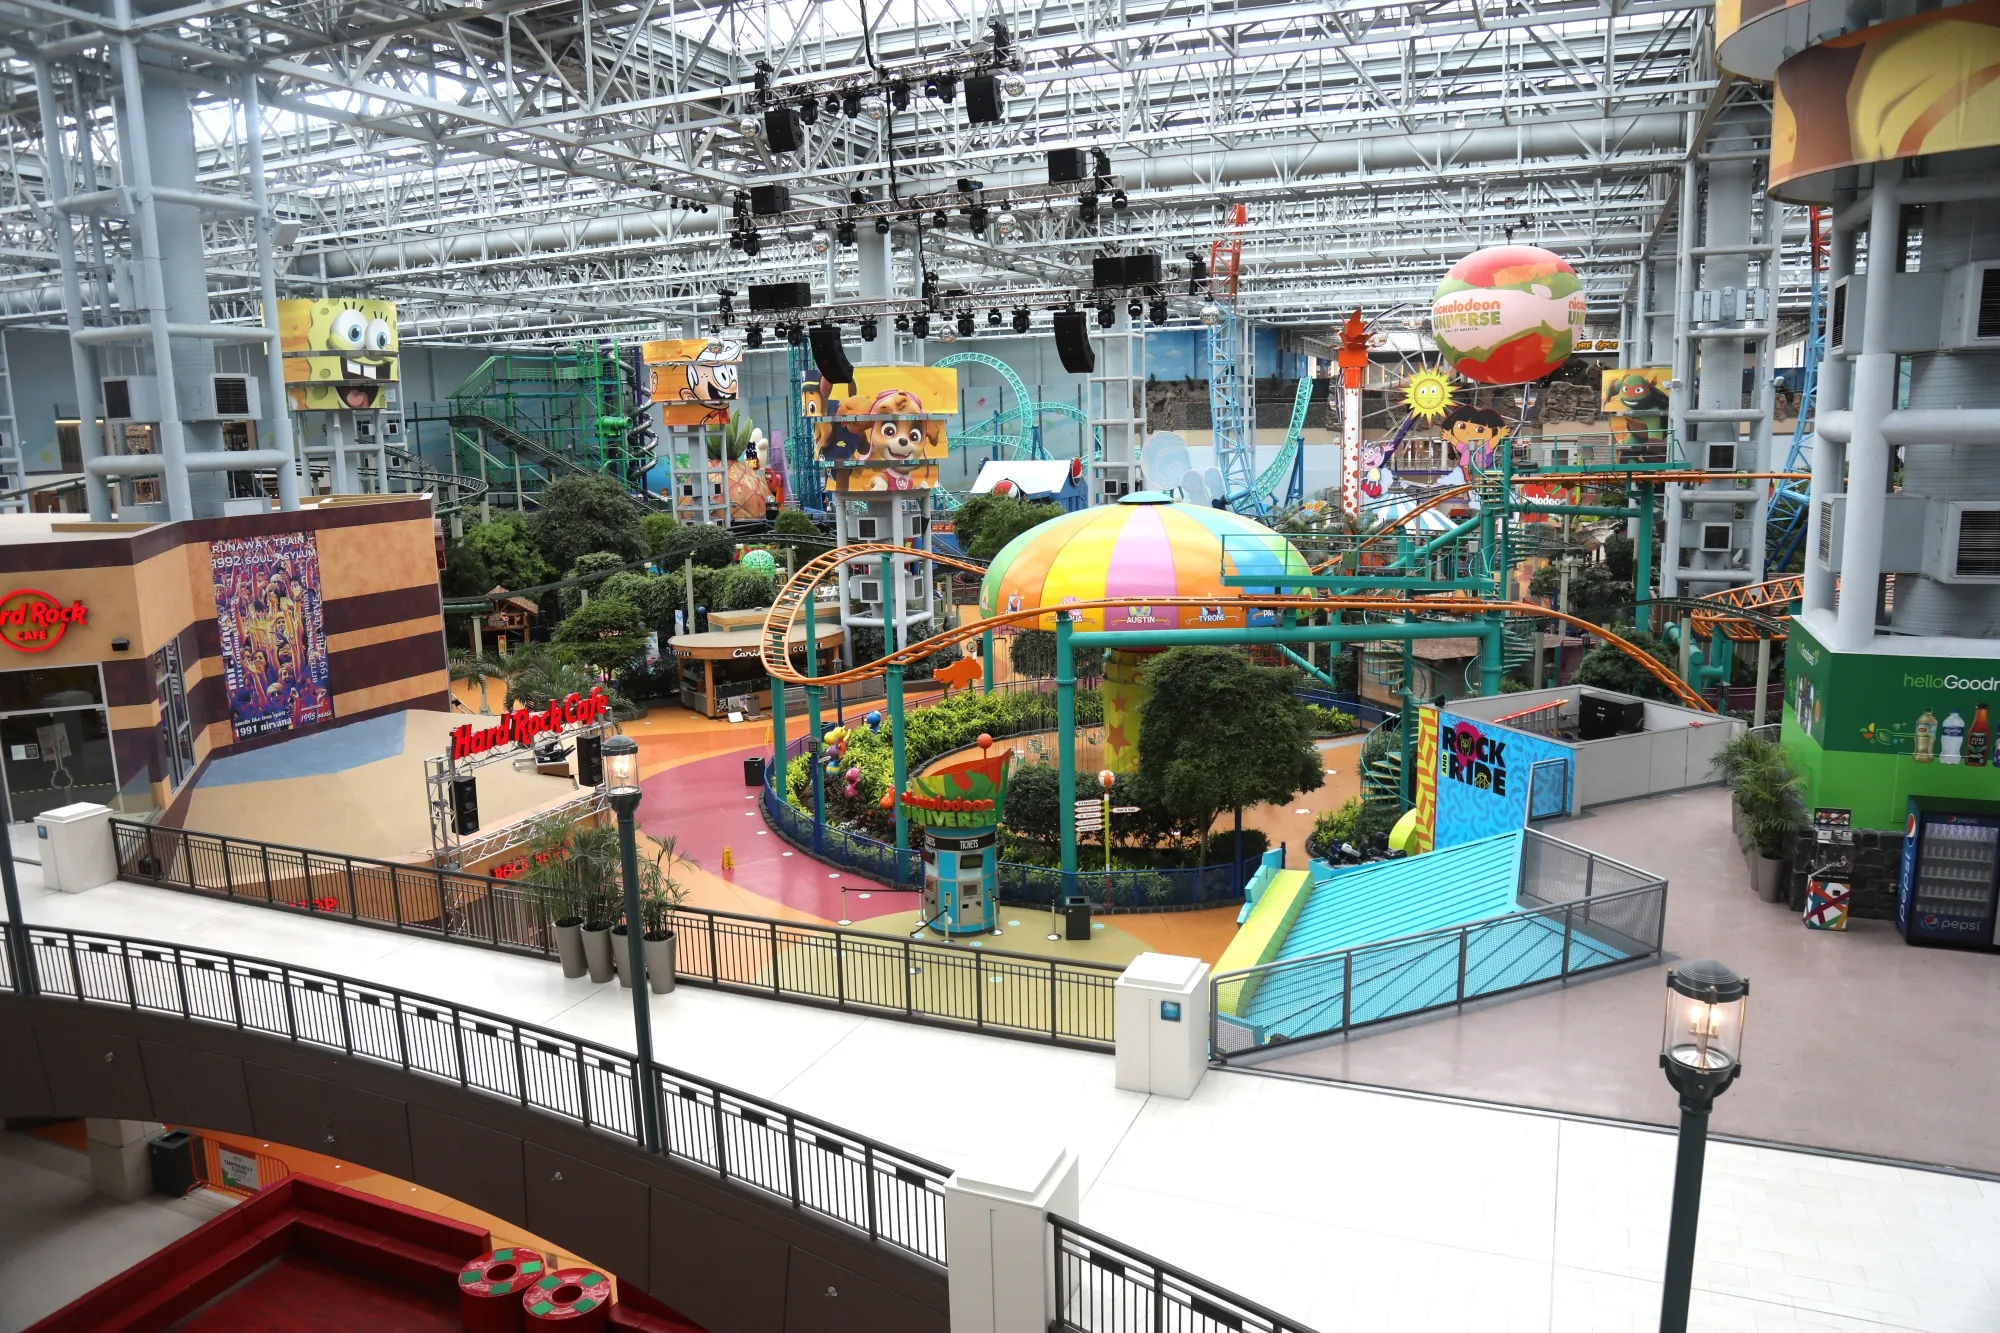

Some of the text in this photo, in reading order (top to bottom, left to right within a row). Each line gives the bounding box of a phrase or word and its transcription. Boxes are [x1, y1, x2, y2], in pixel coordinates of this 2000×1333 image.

[1434, 298, 1501, 315] nickelodeon
[1434, 311, 1501, 329] UNIVERSE
[1595, 340, 1619, 351] GOLF
[211, 535, 304, 554] RUNAWAY TRAIN
[211, 547, 316, 569] 1992 SOUL ASYLUM
[30, 600, 88, 628] Rock
[312, 595, 323, 630] VERVE
[1126, 615, 1156, 624] AUSTIN
[1199, 613, 1226, 623] TYRONE
[16, 629, 47, 641] CAFE
[319, 655, 329, 681] 1997
[234, 718, 251, 728] smells
[251, 715, 261, 724] like
[261, 713, 273, 721] teen
[235, 716, 293, 738] 1991 nirvana
[301, 711, 317, 723] 1995
[450, 686, 609, 760] Hard Rock Cafe
[1442, 725, 1507, 768] ROCK
[1448, 753, 1507, 797] RIDE
[899, 789, 995, 812] nickelodeon
[899, 803, 997, 828] UNIVERSE
[959, 839, 979, 850] TICKETS
[1899, 852, 1912, 922] pepsi
[1940, 920, 1981, 932] pepsi
